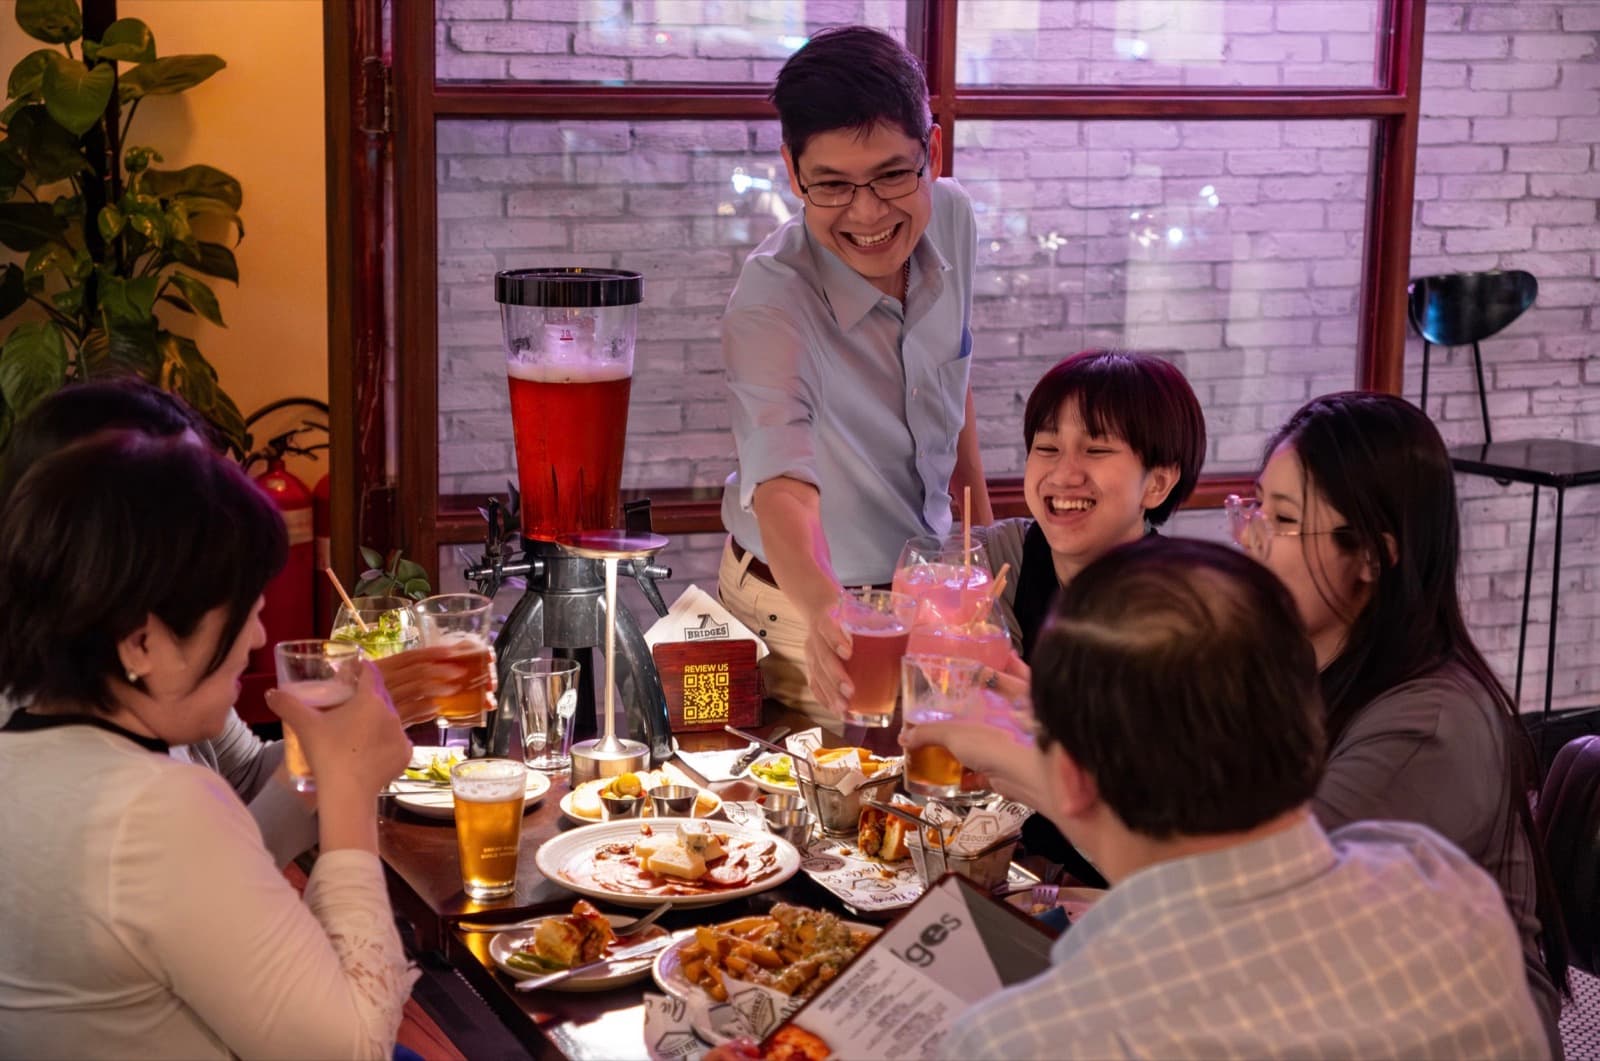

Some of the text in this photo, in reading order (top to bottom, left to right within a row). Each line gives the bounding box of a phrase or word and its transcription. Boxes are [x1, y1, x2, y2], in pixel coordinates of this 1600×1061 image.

[697, 614, 711, 629] 7
[687, 627, 726, 639] BRIDGES
[684, 663, 729, 673] REVIEW US
